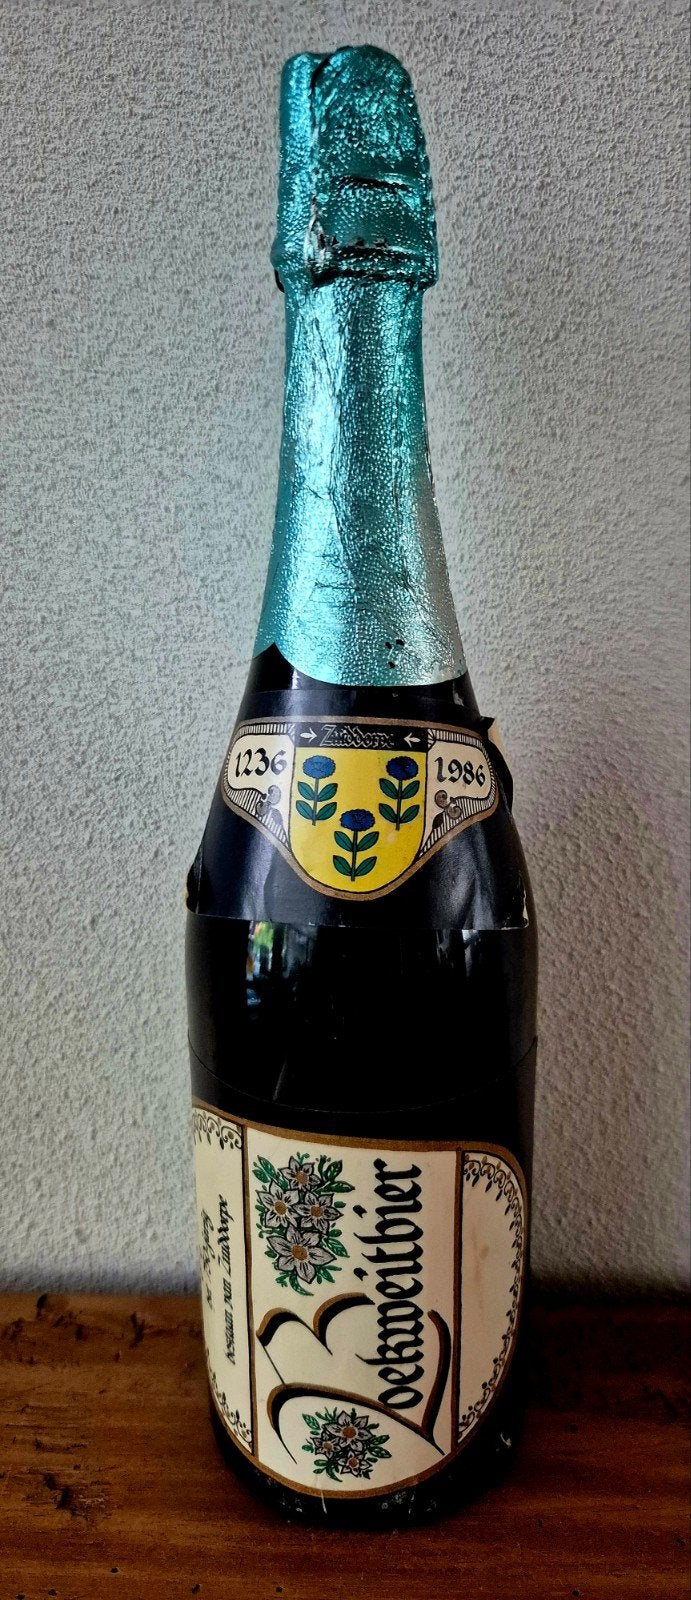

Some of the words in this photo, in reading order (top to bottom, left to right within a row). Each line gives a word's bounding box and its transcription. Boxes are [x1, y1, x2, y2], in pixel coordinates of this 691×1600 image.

[319, 724, 395, 748] Zuiddorpe
[235, 747, 288, 778] 1236
[434, 756, 486, 787] 1986
[217, 1194, 235, 1277] Zuiddorpe
[222, 1277, 234, 1310] van
[256, 1157, 451, 1465] Boekweitbier
